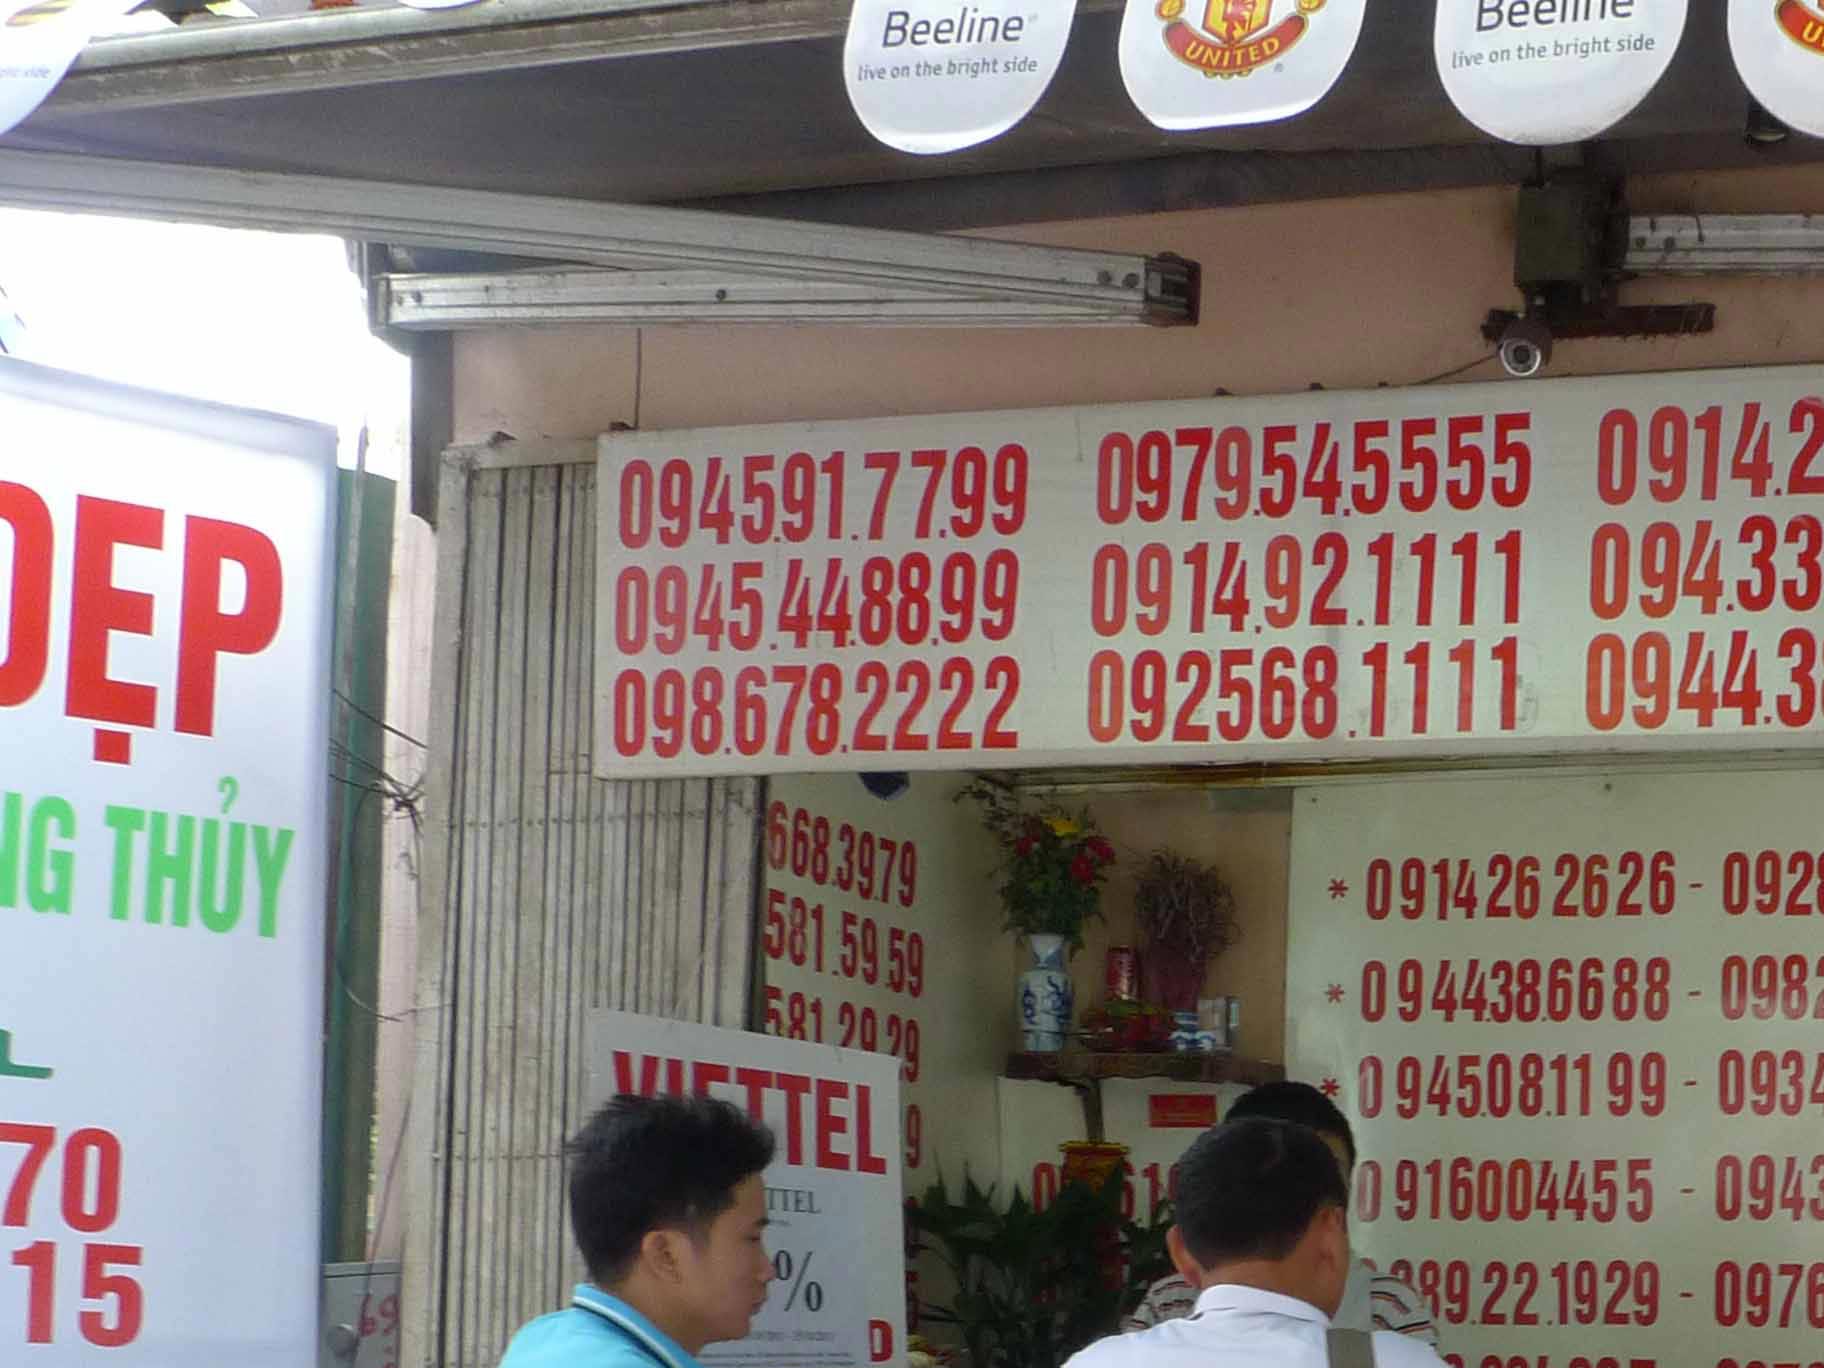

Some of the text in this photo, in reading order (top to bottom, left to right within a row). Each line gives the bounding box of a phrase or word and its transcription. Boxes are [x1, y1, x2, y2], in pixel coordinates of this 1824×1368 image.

[858, 56, 1038, 81] live on the bright side
[881, 12, 1024, 48] Beeline
[1184, 38, 1281, 68] UNITED
[1452, 35, 1656, 68] live on the bright side
[619, 443, 1029, 549] 0945.91.77.99
[1096, 411, 1532, 525] 0979.54.5555
[615, 548, 1020, 656] 0945.44.88.99
[1091, 529, 1523, 638] 0914.92.1111
[613, 655, 1021, 758] 098.678.2222
[1088, 636, 1519, 744] 092568.1111
[0, 775, 295, 939] G THỦY
